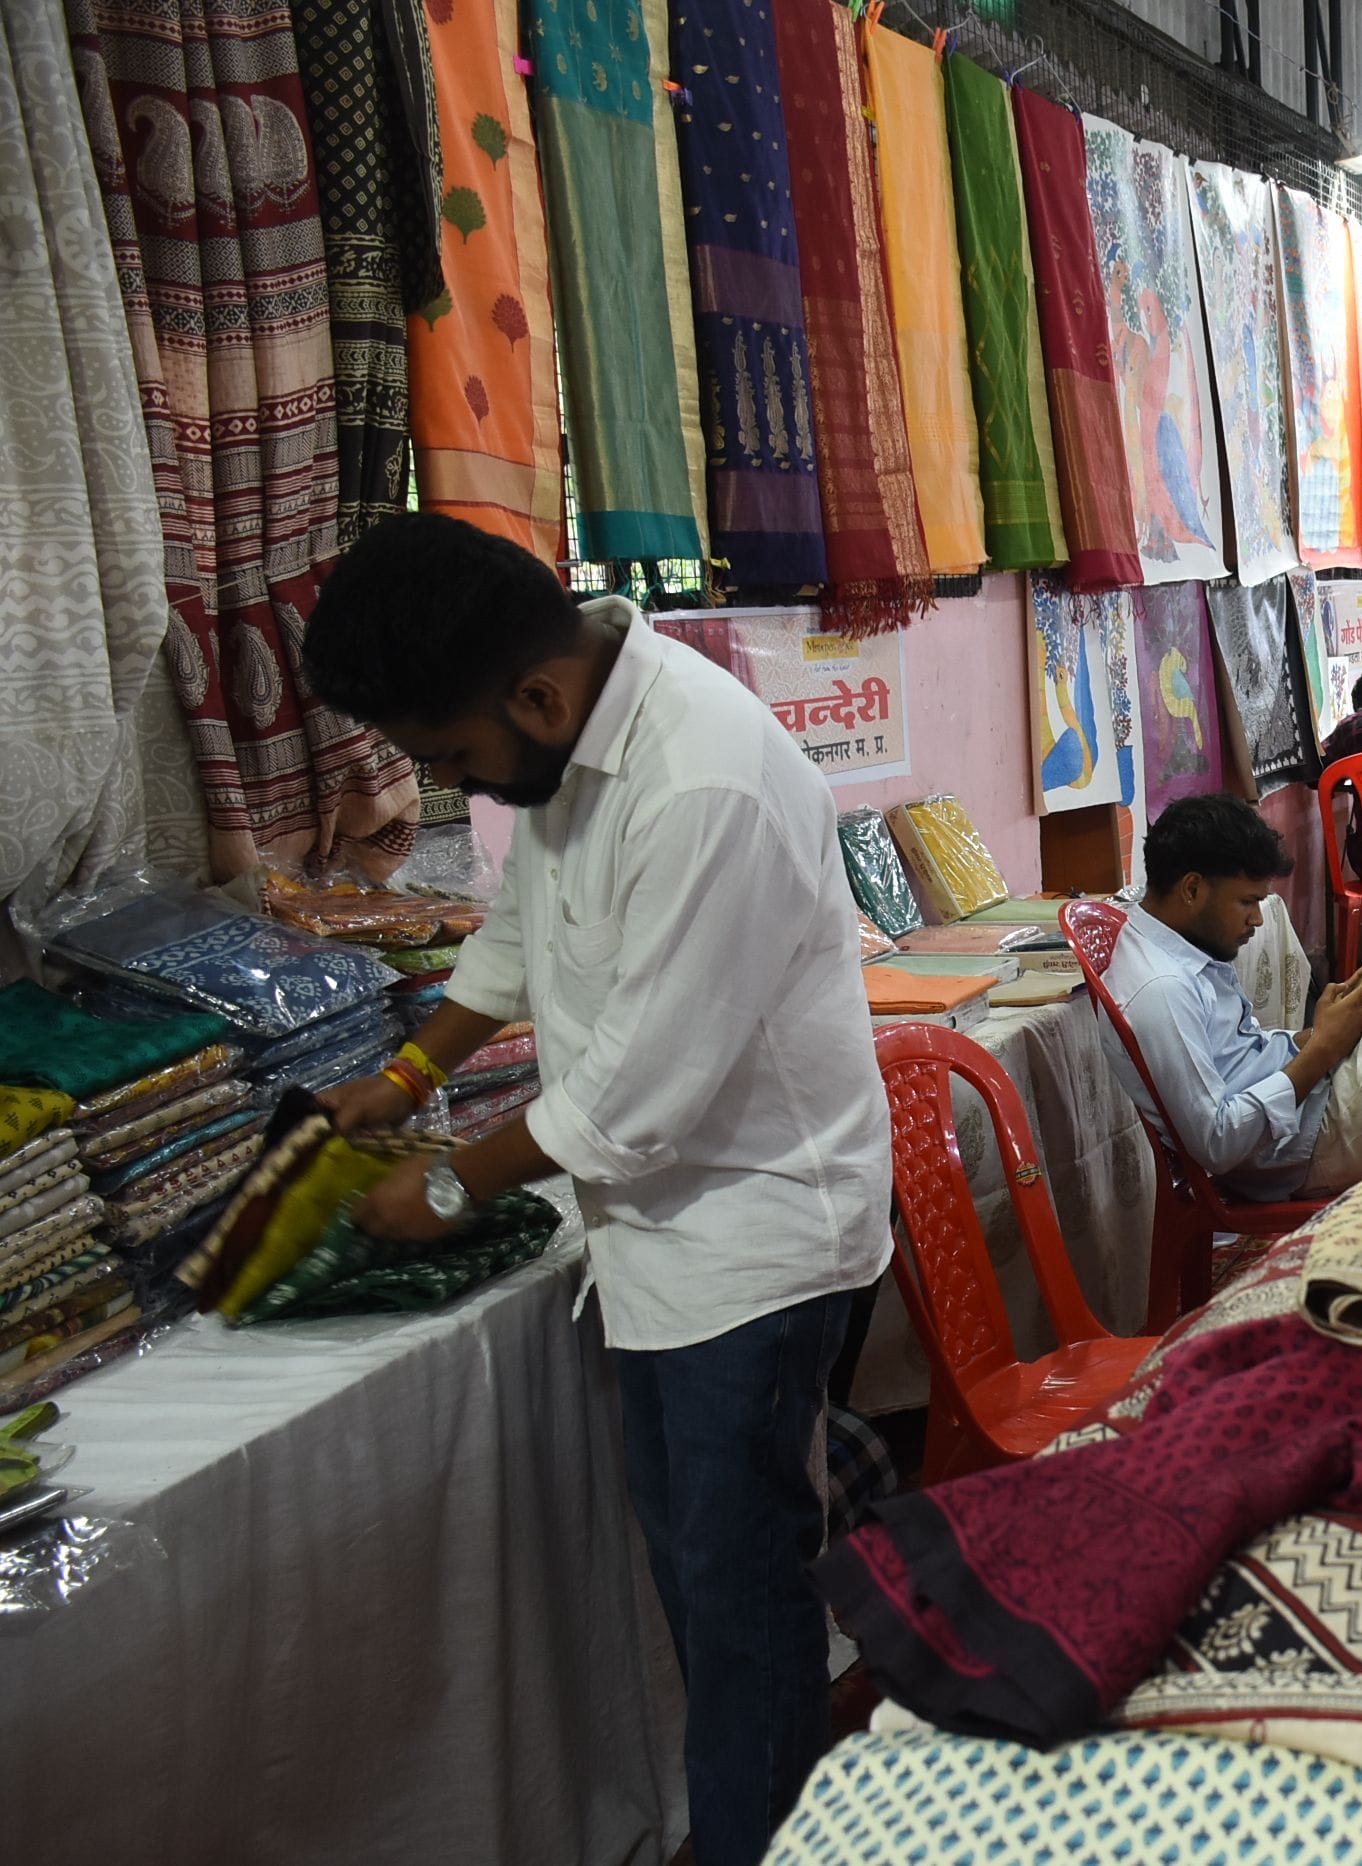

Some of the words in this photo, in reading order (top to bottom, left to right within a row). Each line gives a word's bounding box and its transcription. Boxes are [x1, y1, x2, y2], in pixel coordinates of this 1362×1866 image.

[1341, 619, 1355, 644] गोंड
[770, 677, 890, 732] चन्देरी
[801, 739, 850, 764] ोकनगर
[855, 739, 869, 757] म.
[874, 735, 887, 754] प्र.
